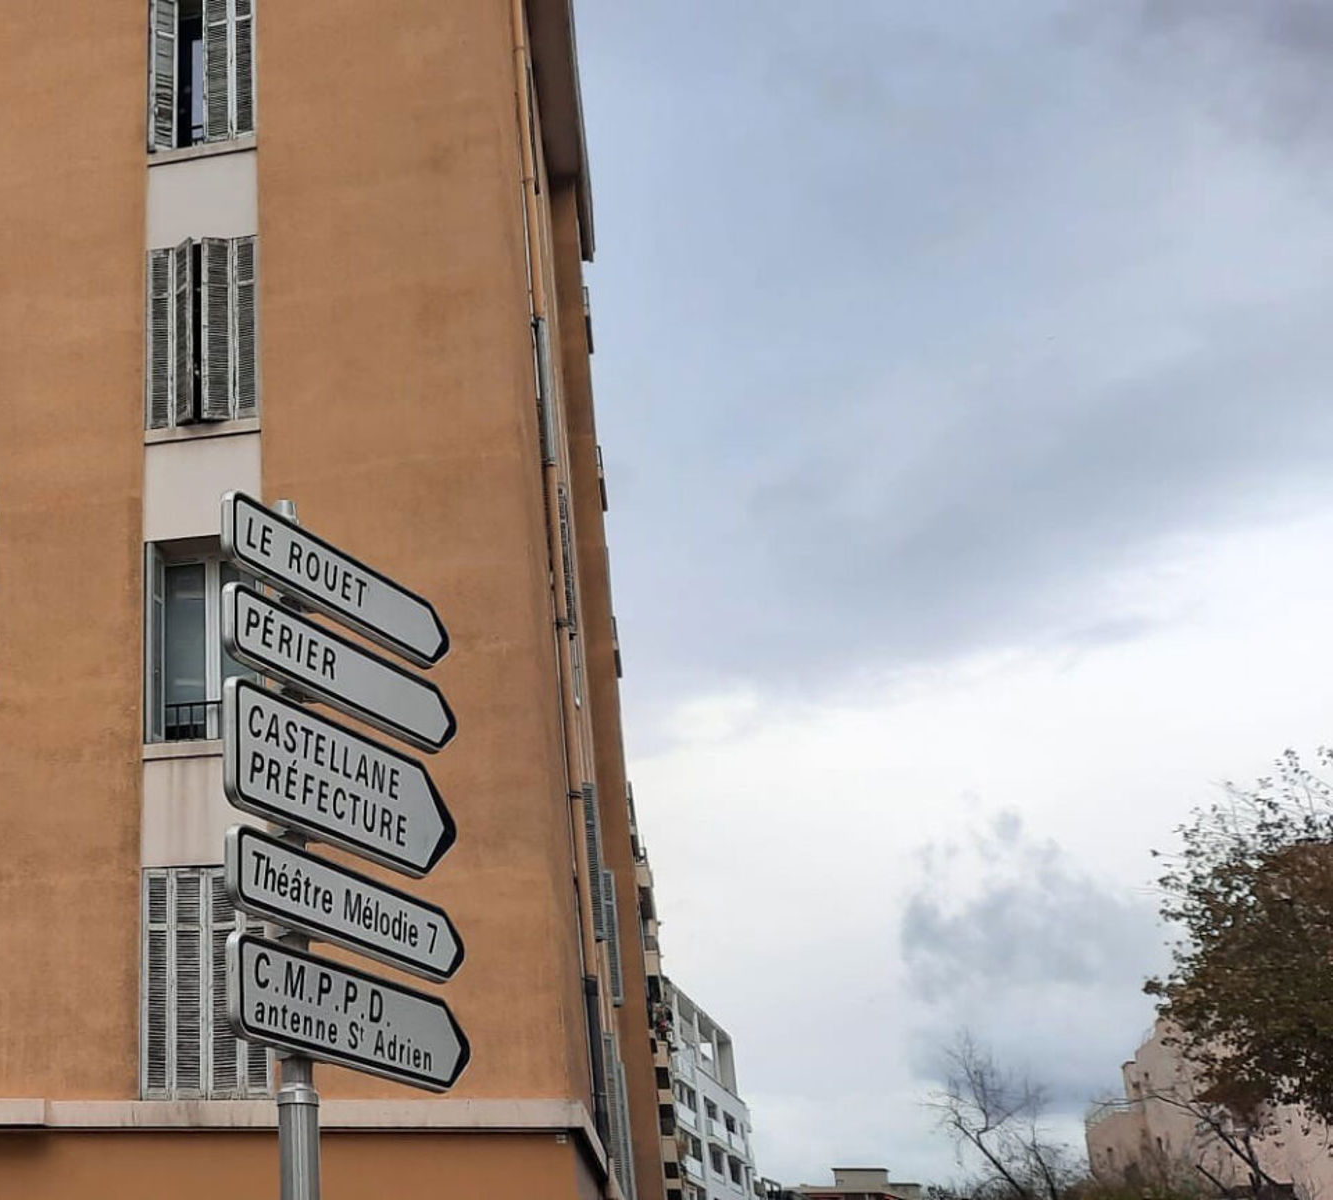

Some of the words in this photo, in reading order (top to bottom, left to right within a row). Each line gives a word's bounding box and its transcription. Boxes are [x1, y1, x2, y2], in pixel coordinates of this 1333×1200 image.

[245, 517, 273, 557] LE
[288, 542, 367, 607] ROUET
[245, 607, 336, 680] PÉRIER
[249, 705, 400, 798] CASTELLANE
[250, 752, 407, 846] PRÉFECTURE
[252, 851, 332, 914] Théâtre
[344, 888, 419, 947] Mélodie
[426, 923, 438, 955] 7
[254, 952, 391, 1026] C.M.P.P.D.
[255, 1002, 337, 1043] antenne
[347, 1024, 364, 1049] St
[374, 1030, 432, 1072] Adrien
